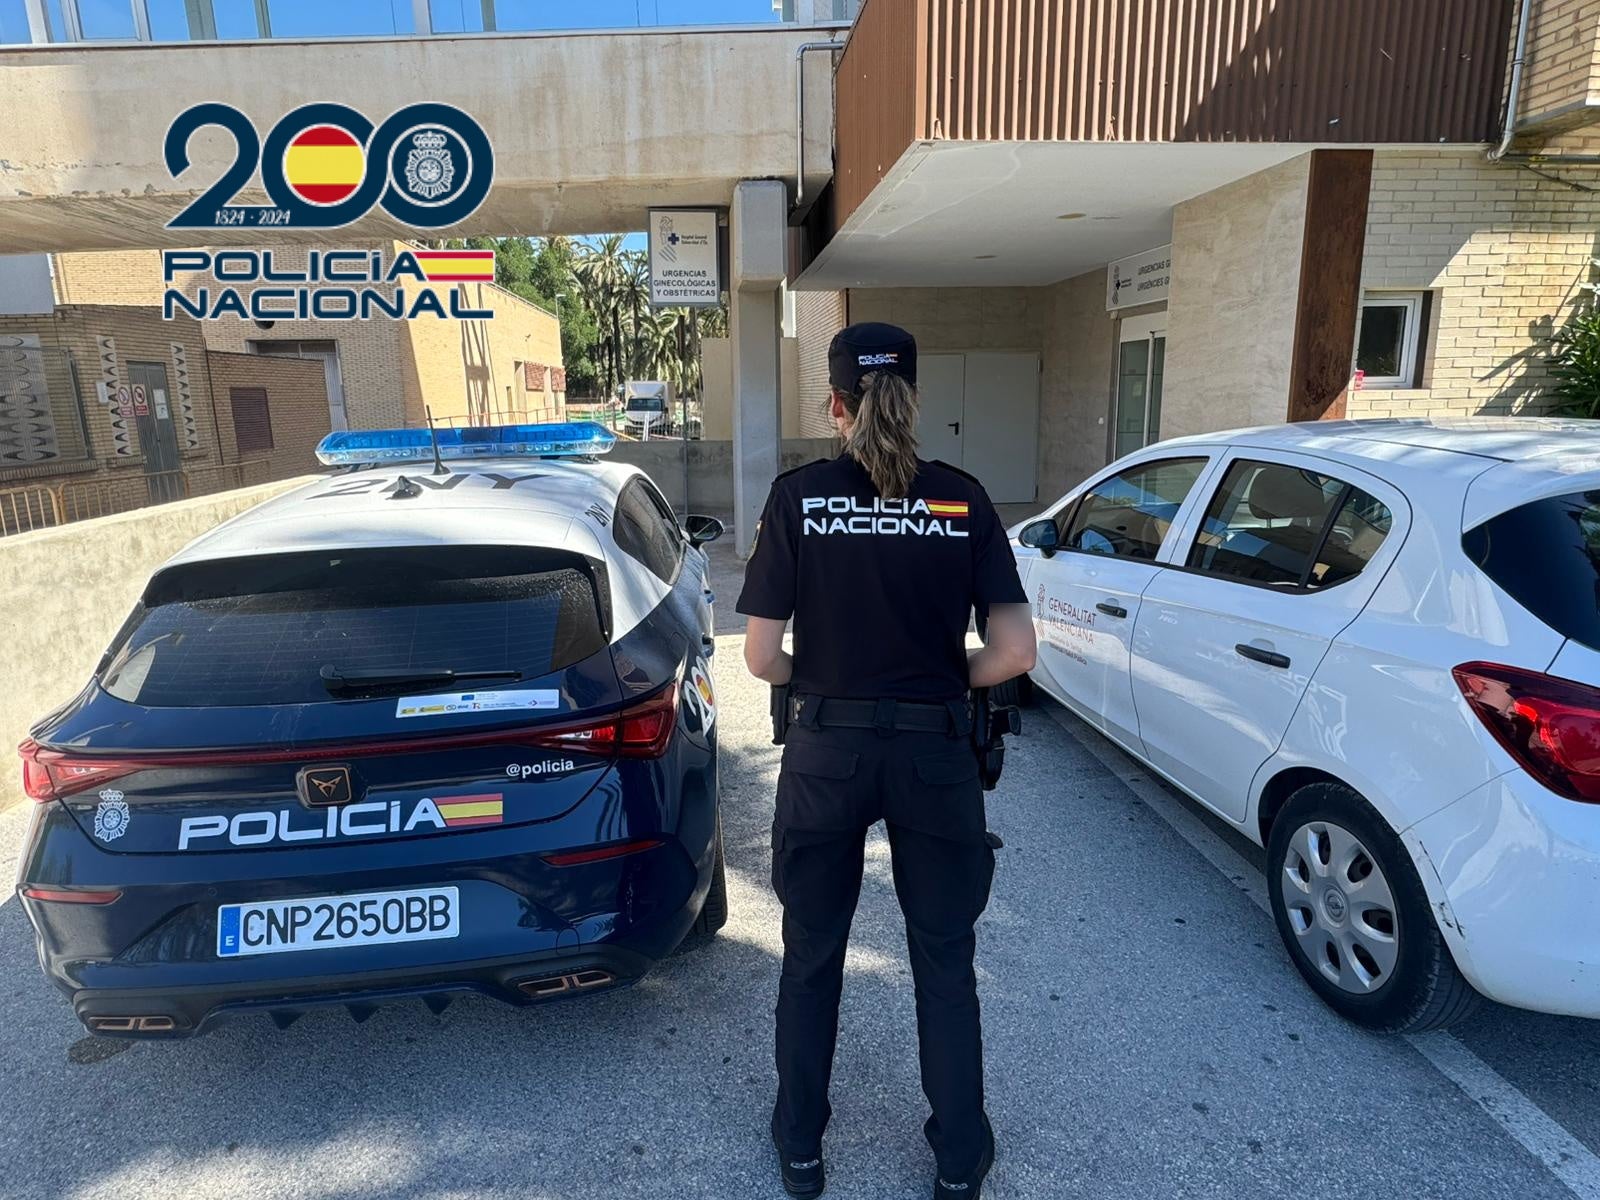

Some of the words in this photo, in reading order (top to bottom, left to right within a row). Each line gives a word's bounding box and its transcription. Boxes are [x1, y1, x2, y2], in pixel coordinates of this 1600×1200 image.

[662, 270, 707, 278] URGENCIAS
[656, 289, 662, 297] Y
[803, 516, 969, 537] NACIONAL
[1048, 597, 1098, 627] GENERALITAT
[1047, 614, 1095, 645] VALENCIANA
[505, 758, 575, 778] @policia
[225, 935, 235, 947] E
[242, 894, 452, 948] CNP2650BB
